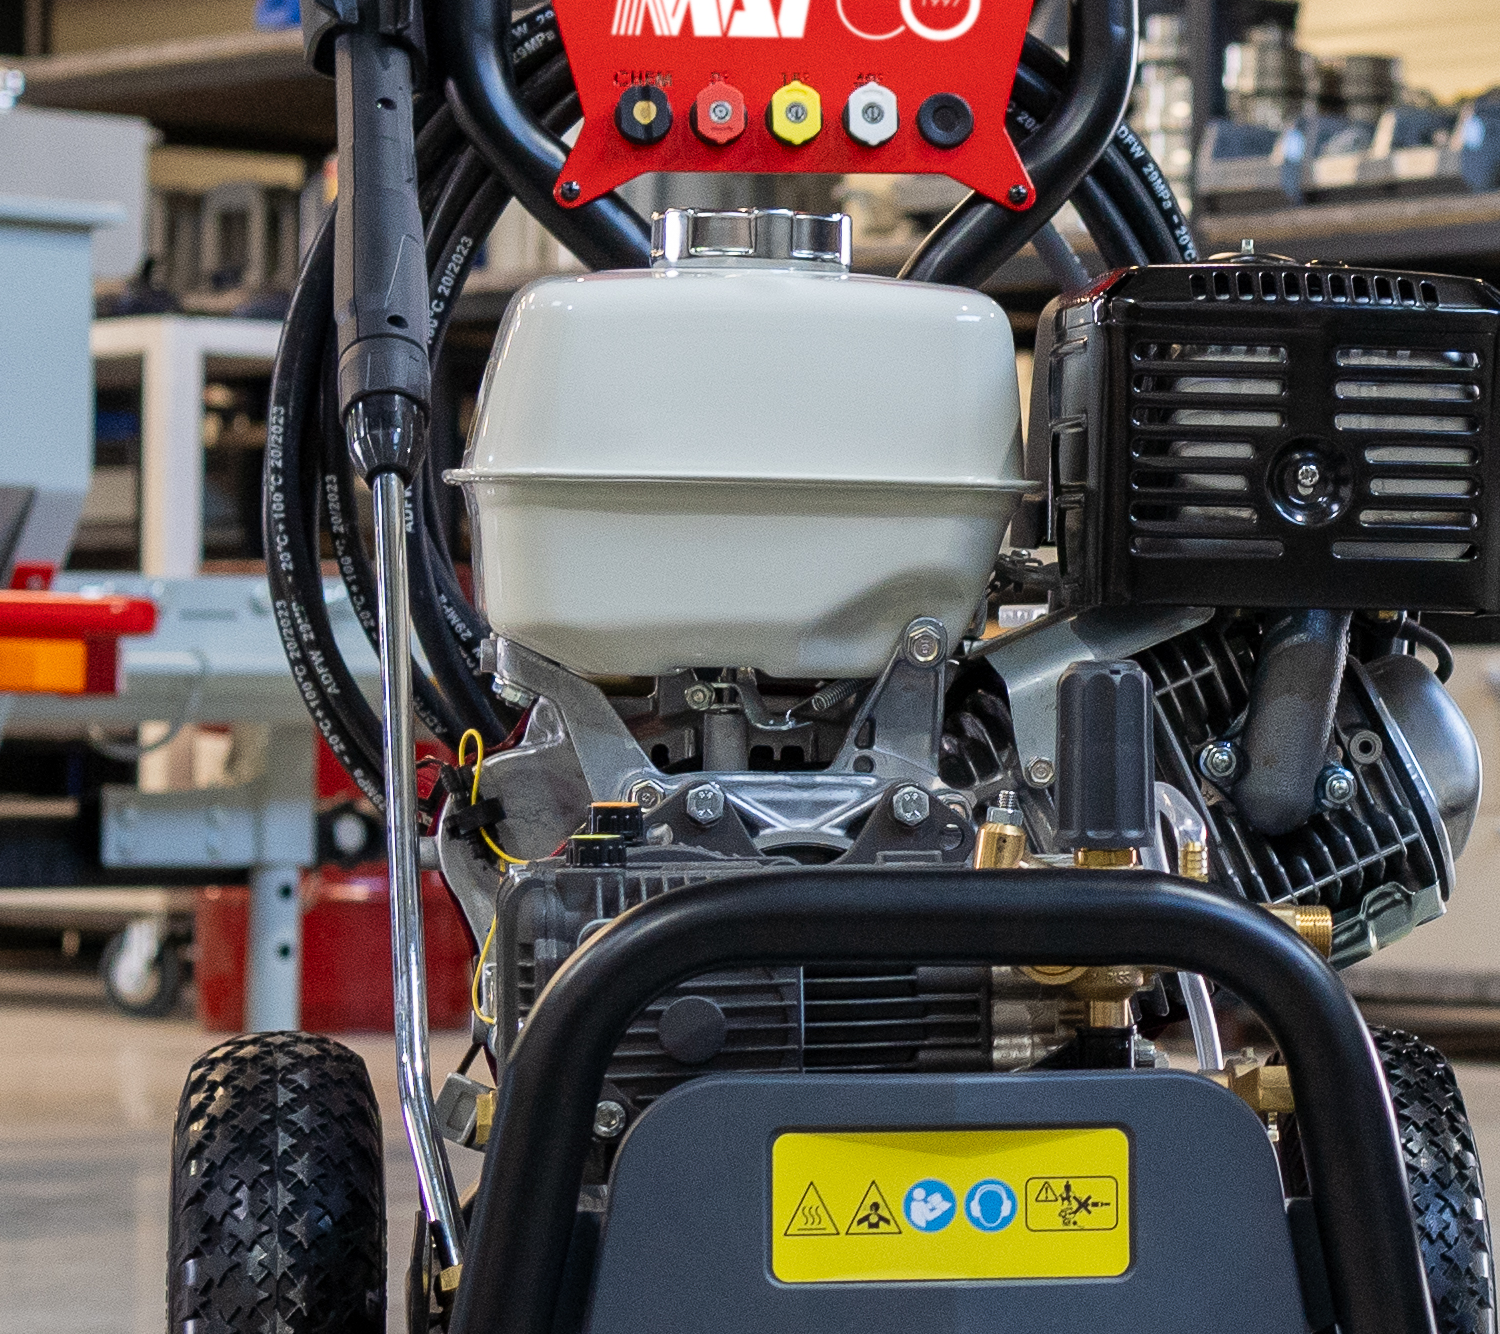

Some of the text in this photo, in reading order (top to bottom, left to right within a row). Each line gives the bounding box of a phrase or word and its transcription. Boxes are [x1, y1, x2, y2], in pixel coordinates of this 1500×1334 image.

[1116, 123, 1146, 160] DFW
[437, 235, 474, 298] 20/2023
[269, 405, 286, 469] 20/2023
[324, 473, 345, 534] 20/2023
[275, 599, 303, 661] 20/2023
